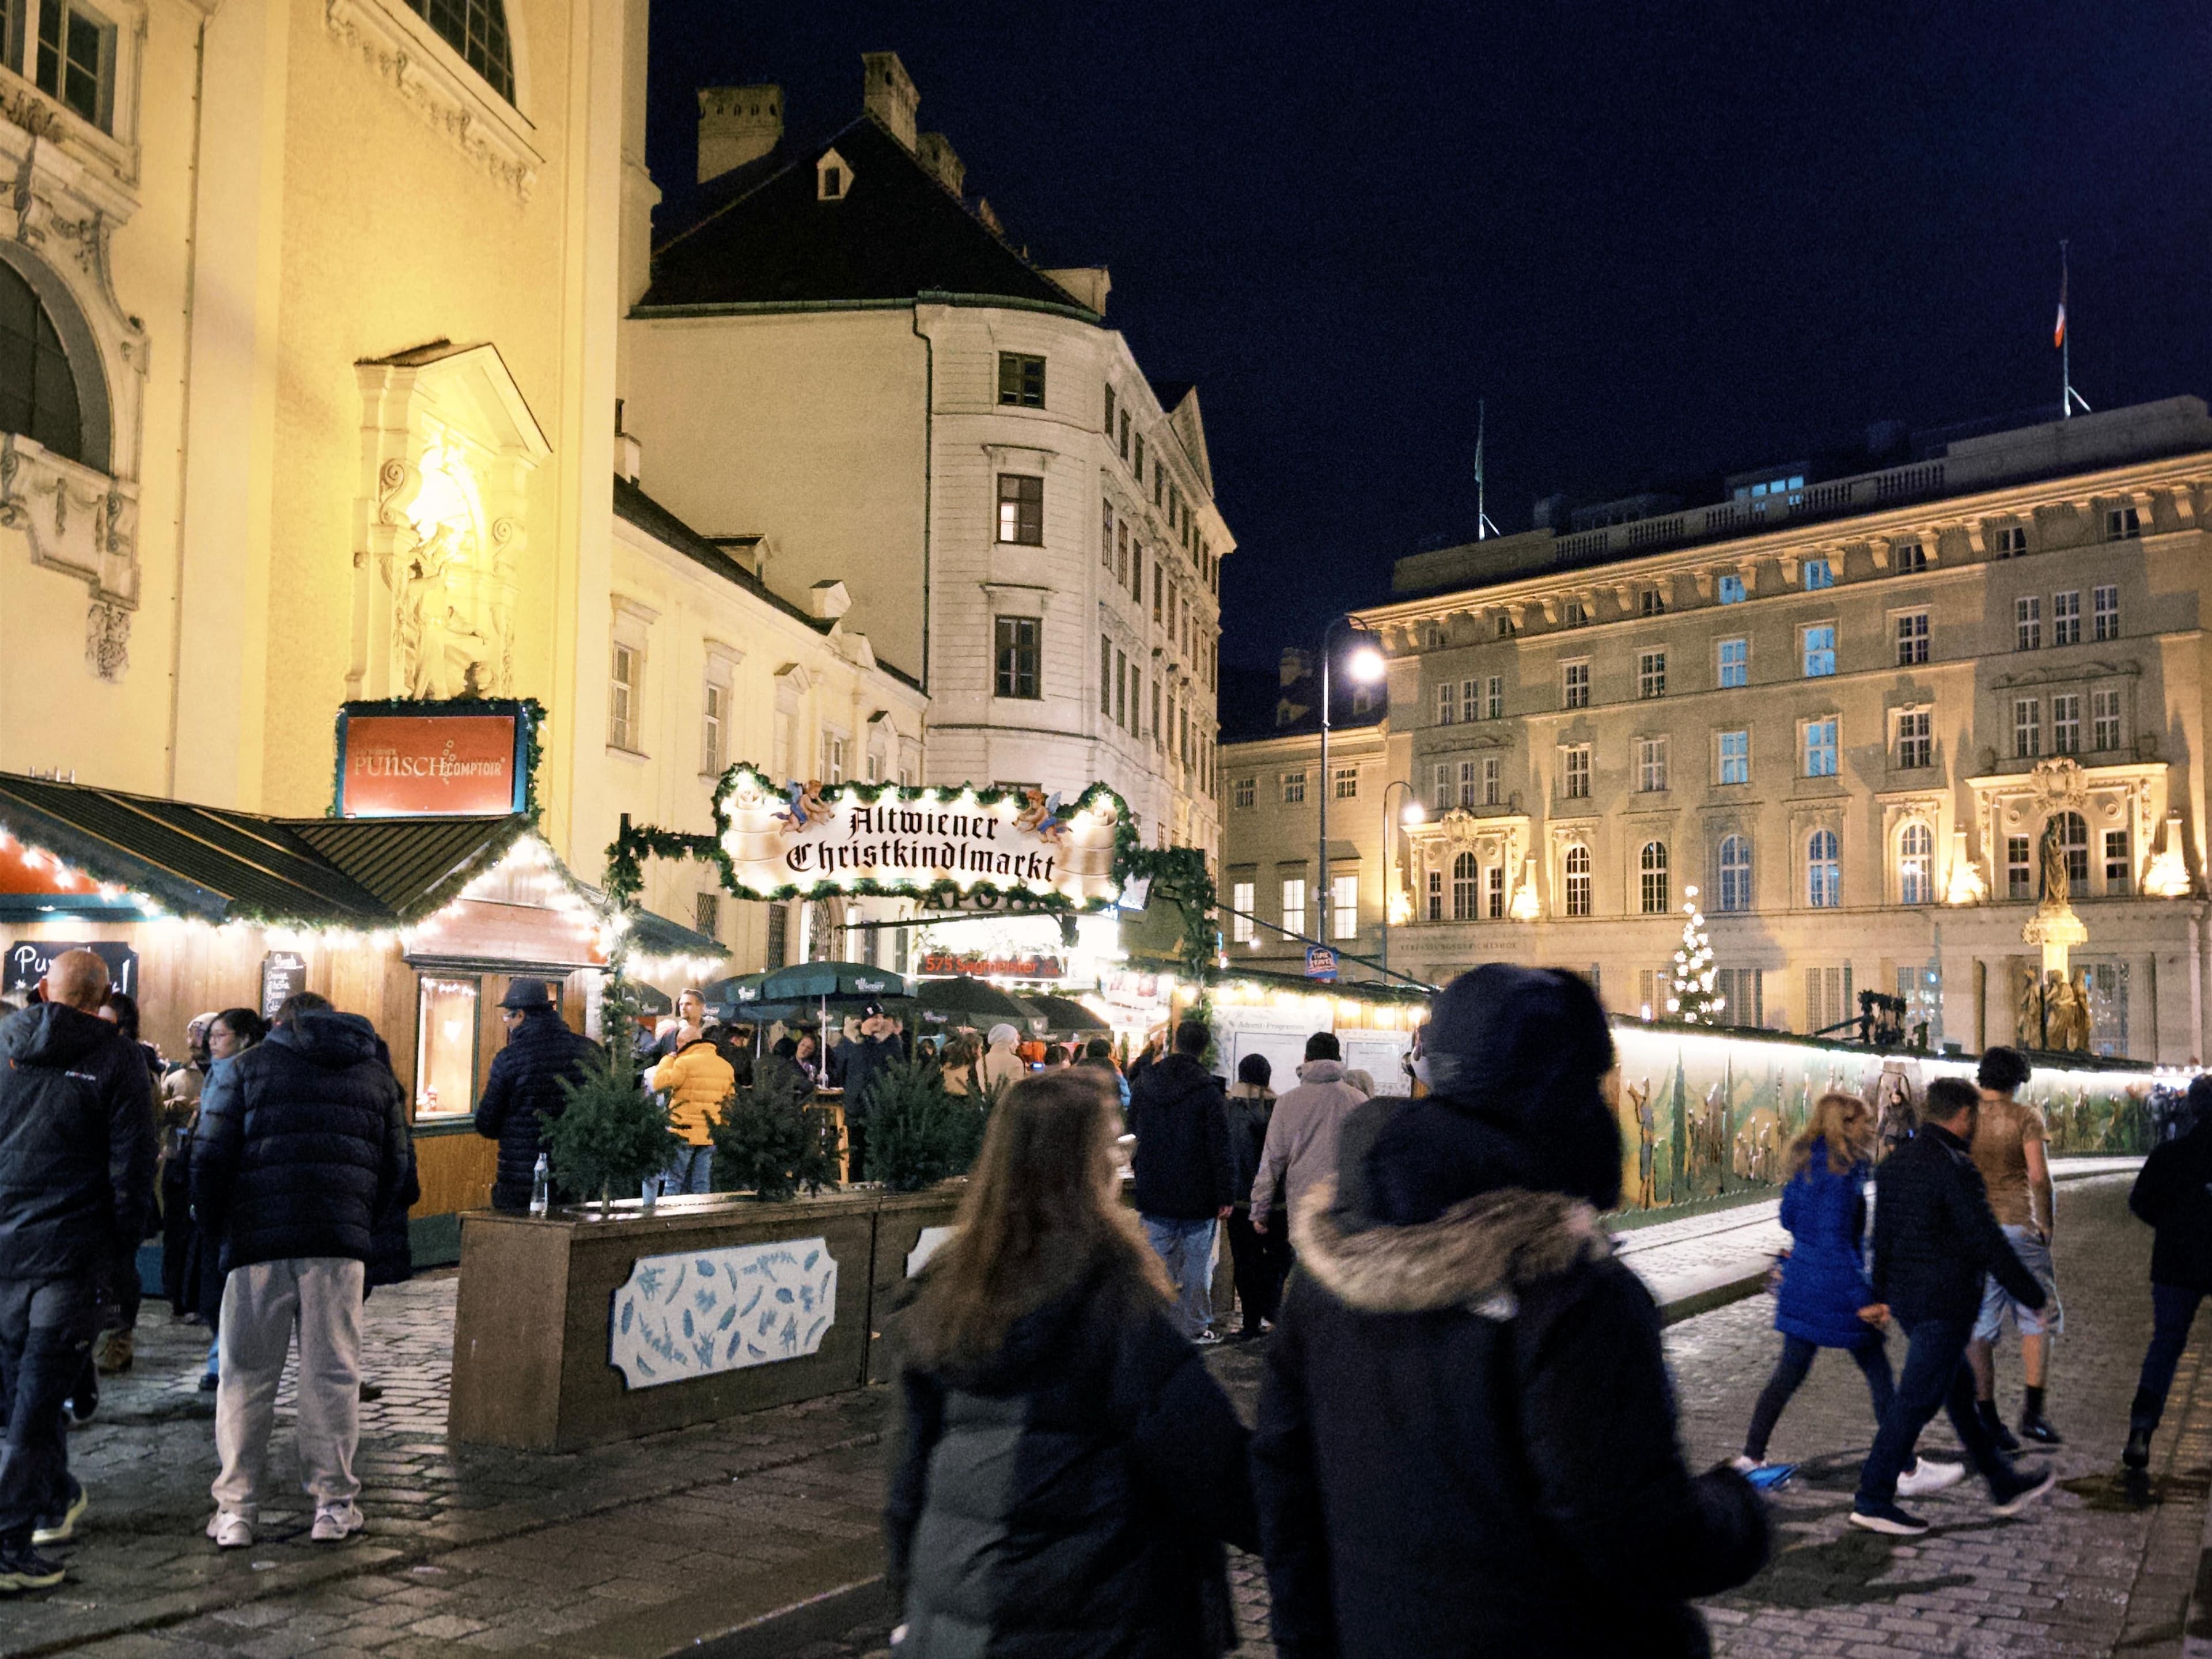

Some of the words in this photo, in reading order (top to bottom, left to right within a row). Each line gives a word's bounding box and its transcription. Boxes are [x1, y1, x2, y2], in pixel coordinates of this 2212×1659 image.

[446, 762, 502, 776] COMPTOIR
[848, 806, 998, 840] Altwiener
[786, 838, 1056, 882] Christkindlmarkt
[925, 957, 953, 972] 575
[956, 959, 1039, 975] Sagmeister
